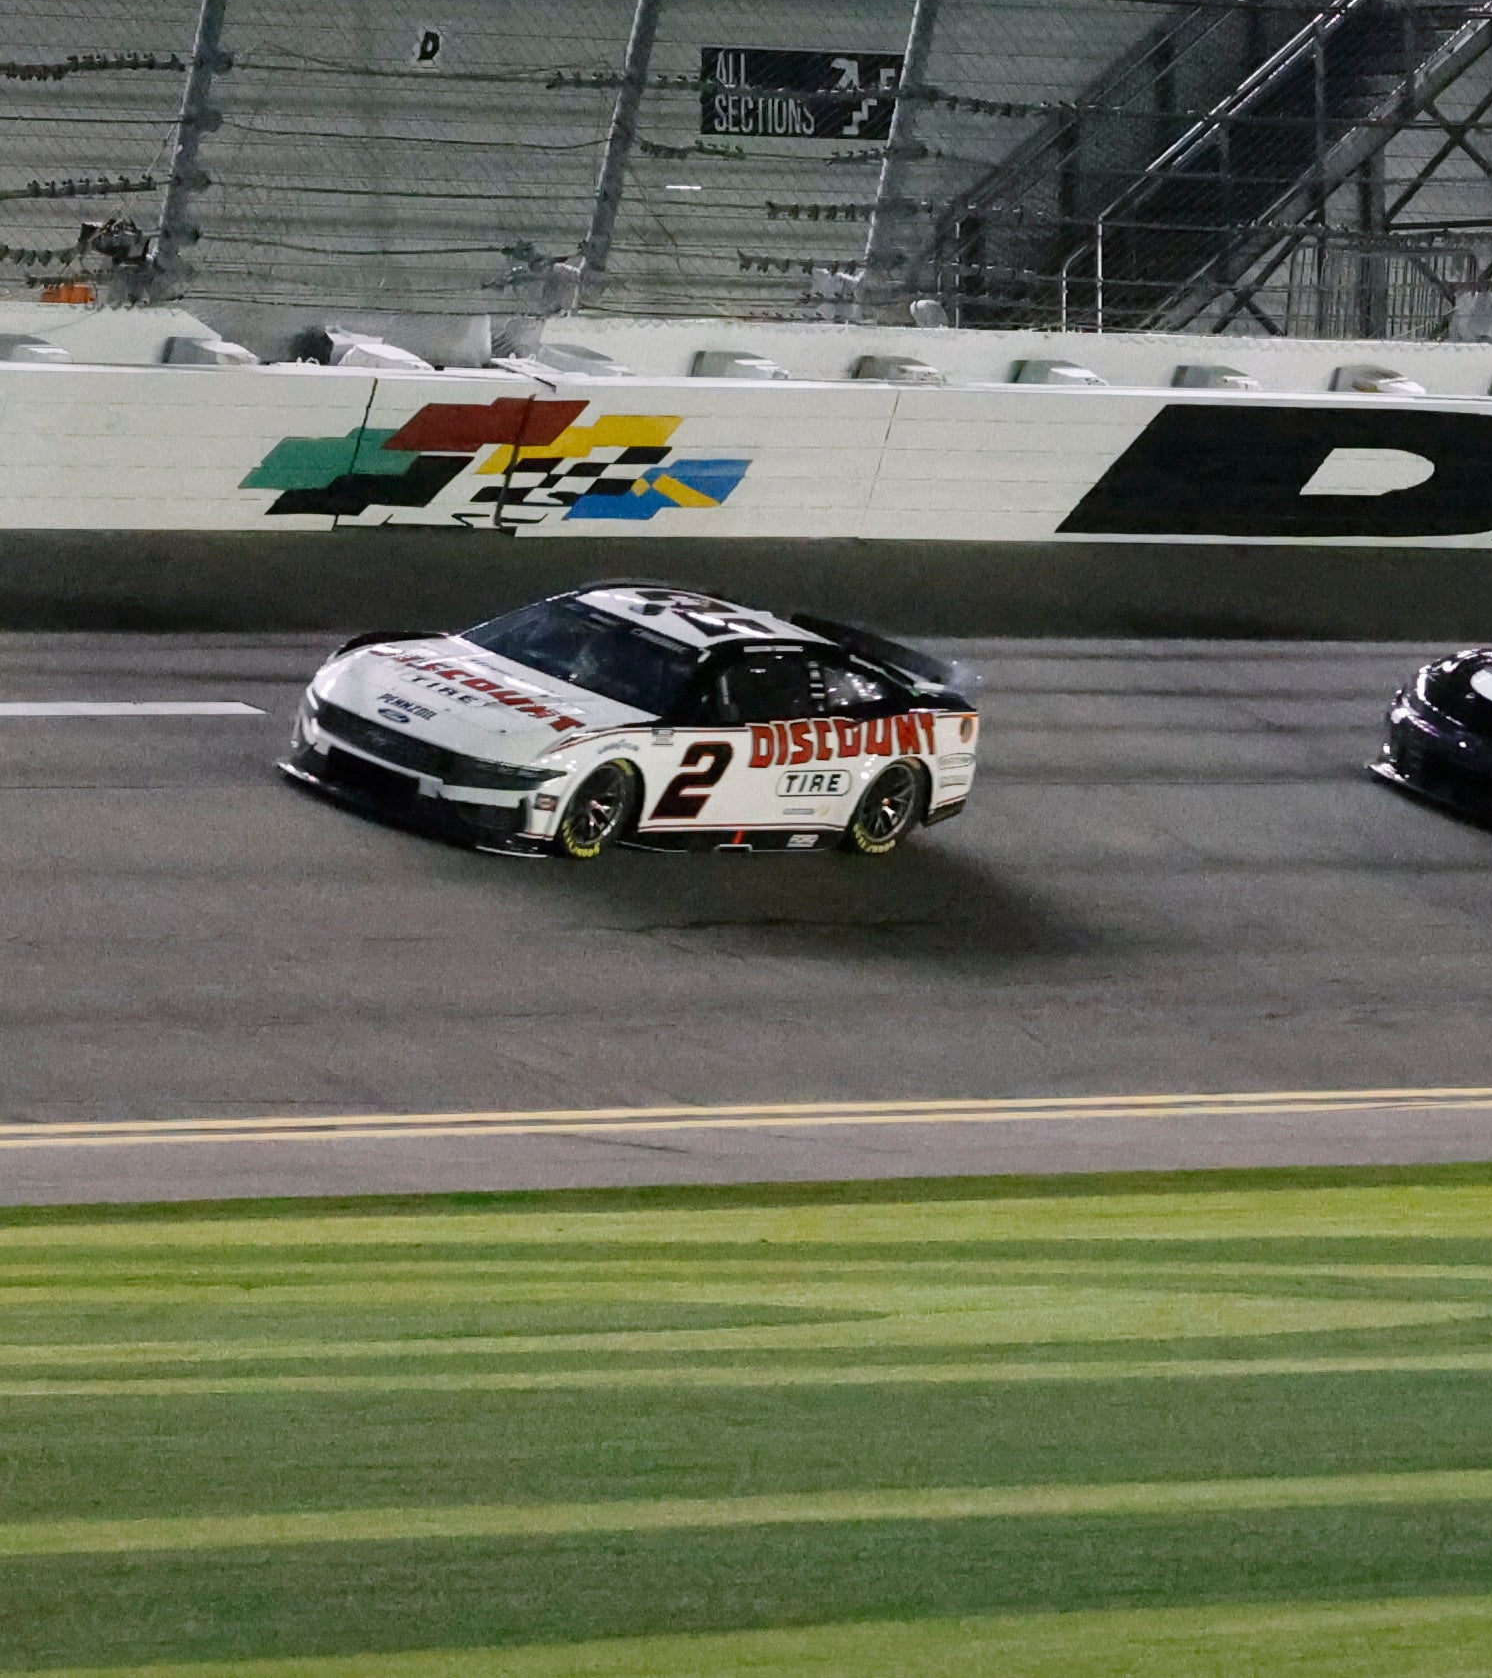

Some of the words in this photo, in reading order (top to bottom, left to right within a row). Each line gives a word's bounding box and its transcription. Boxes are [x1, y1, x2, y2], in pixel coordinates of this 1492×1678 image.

[716, 50, 750, 88] ALL
[713, 94, 815, 135] SECTIONS
[411, 674, 478, 705] TIRE
[748, 713, 935, 768] DISCOUNT
[648, 740, 734, 821] 2
[785, 773, 842, 793] TIRE
